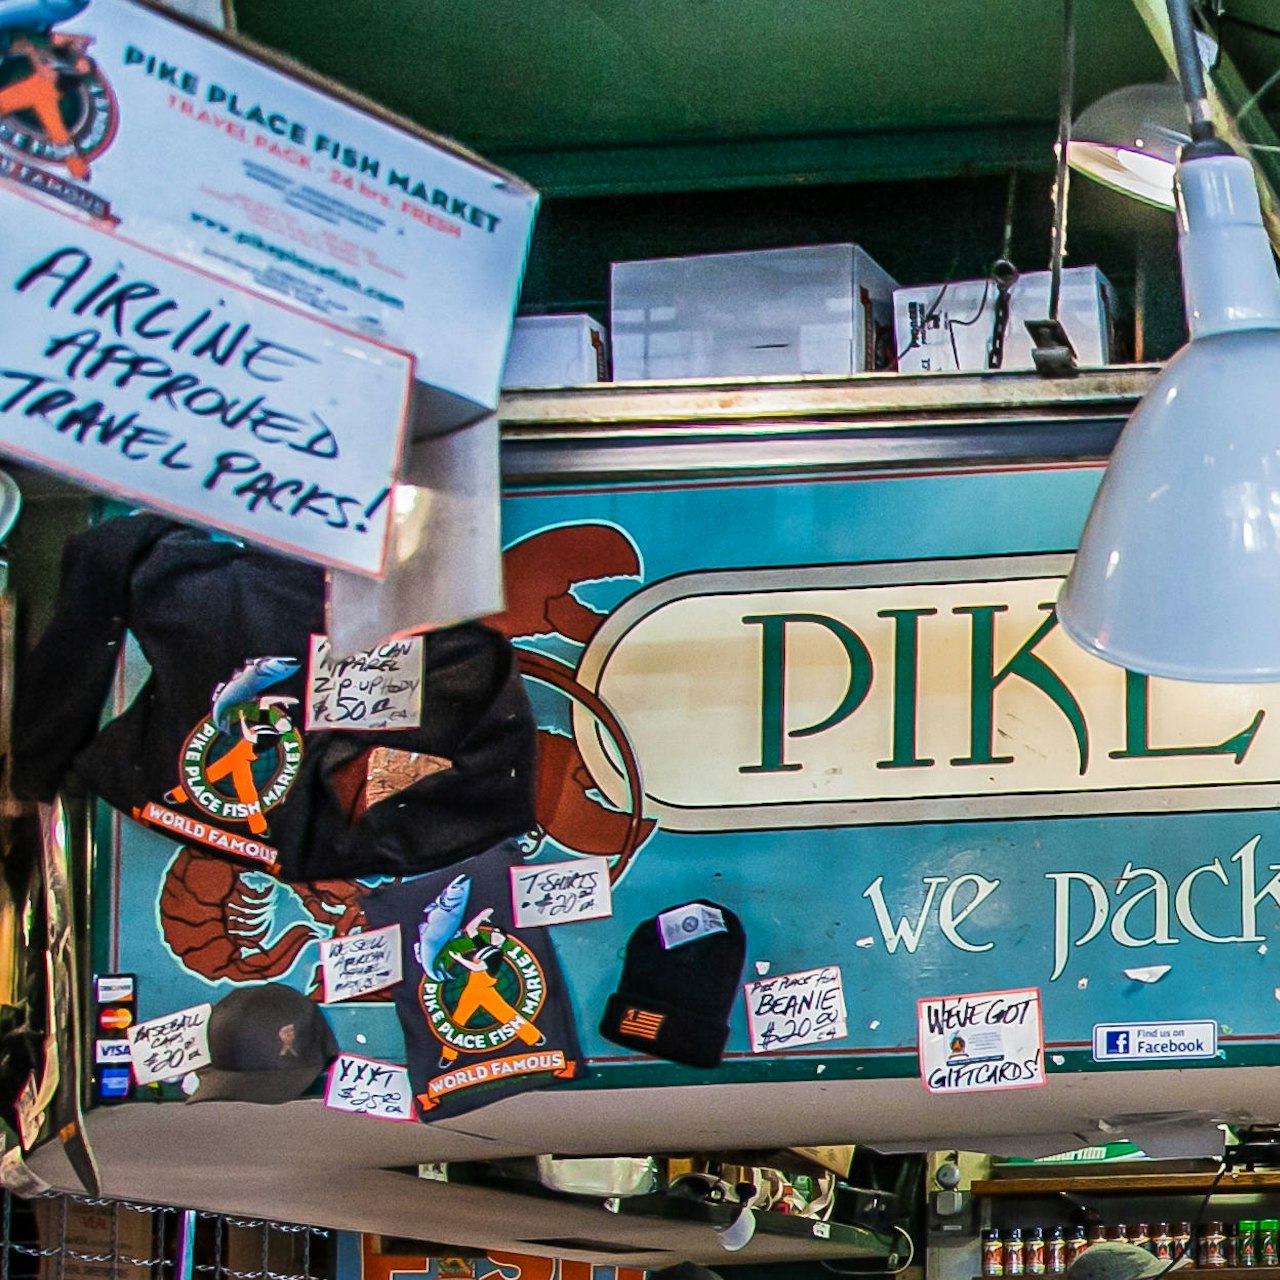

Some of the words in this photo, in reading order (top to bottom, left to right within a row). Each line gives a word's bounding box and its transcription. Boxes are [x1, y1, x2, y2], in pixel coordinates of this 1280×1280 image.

[123, 44, 199, 96] PIKE
[206, 81, 309, 149] PLACE
[313, 122, 380, 178] FISH
[388, 160, 501, 234] MARKET
[14, 246, 321, 382] AIRLINE
[45, 328, 338, 460] APPROVED
[1, 369, 191, 471] TRAVEL
[203, 450, 392, 536] PACKS!
[185, 723, 215, 761] PIKE
[185, 766, 222, 813] PLACE
[263, 741, 300, 806] MARKET
[222, 801, 261, 817] FISH
[147, 803, 205, 842] WORLD
[207, 829, 279, 864] FAMOUS
[519, 870, 599, 894] T-SHIRTS
[863, 873, 999, 954] we
[507, 946, 542, 1014] MARKET
[423, 983, 445, 1023] PIKE
[754, 988, 840, 1016] BEANIE
[985, 997, 1039, 1026] GOT
[134, 1006, 205, 1042] BASEBALL
[438, 1024, 487, 1049] PLACE
[488, 1015, 527, 1045] FISH
[1137, 1029, 1157, 1038] Find
[101, 1045, 131, 1057] VISA
[1137, 1039, 1204, 1054] Facebook
[430, 1066, 488, 1093] WORLD
[491, 1054, 563, 1072] FAMOUS
